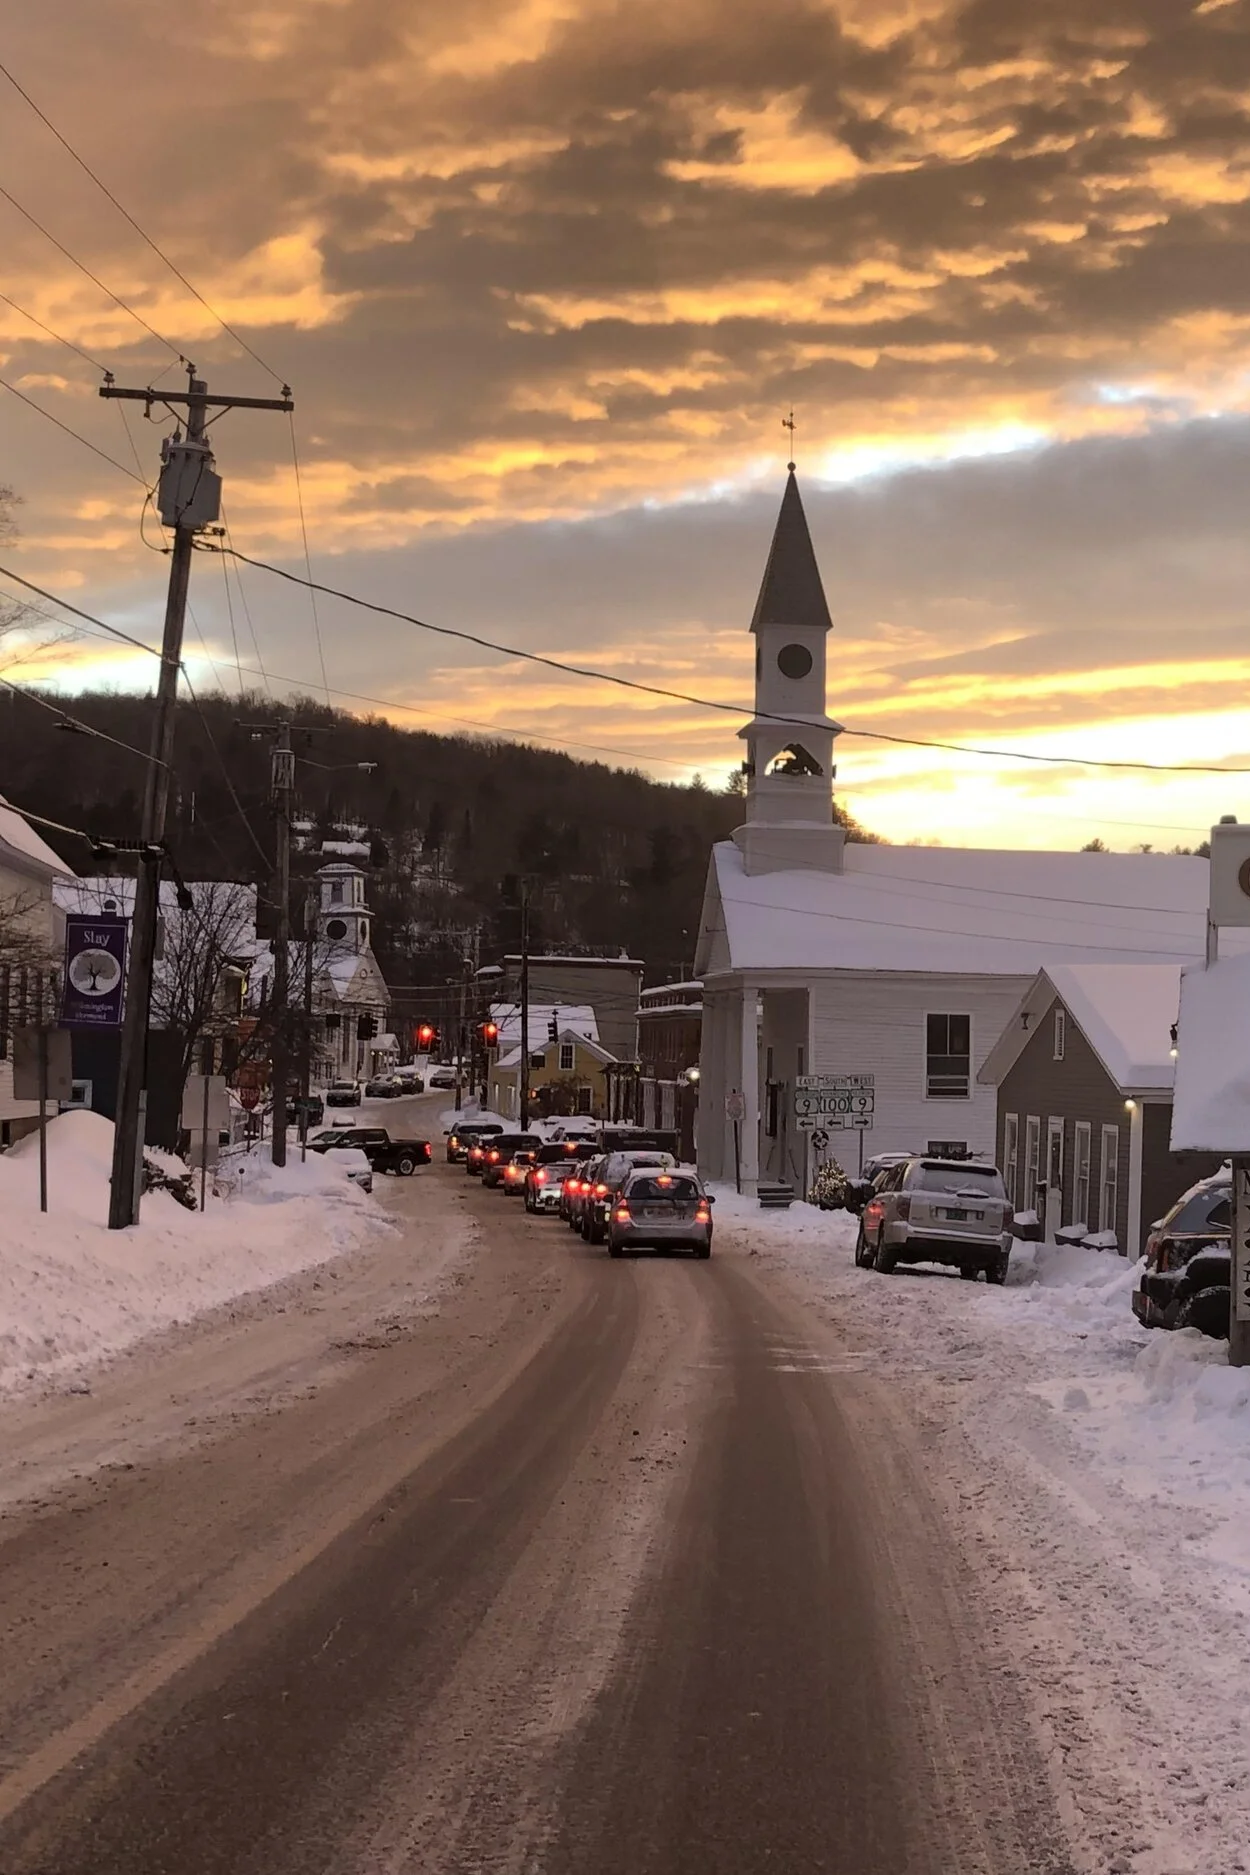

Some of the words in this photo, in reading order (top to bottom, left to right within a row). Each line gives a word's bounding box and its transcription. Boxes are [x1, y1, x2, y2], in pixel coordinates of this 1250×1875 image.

[83, 930, 110, 947] Stay
[241, 1088, 260, 1101] STOP
[803, 1099, 811, 1113] 9
[823, 1098, 847, 1112] 100
[858, 1097, 867, 1111] 9
